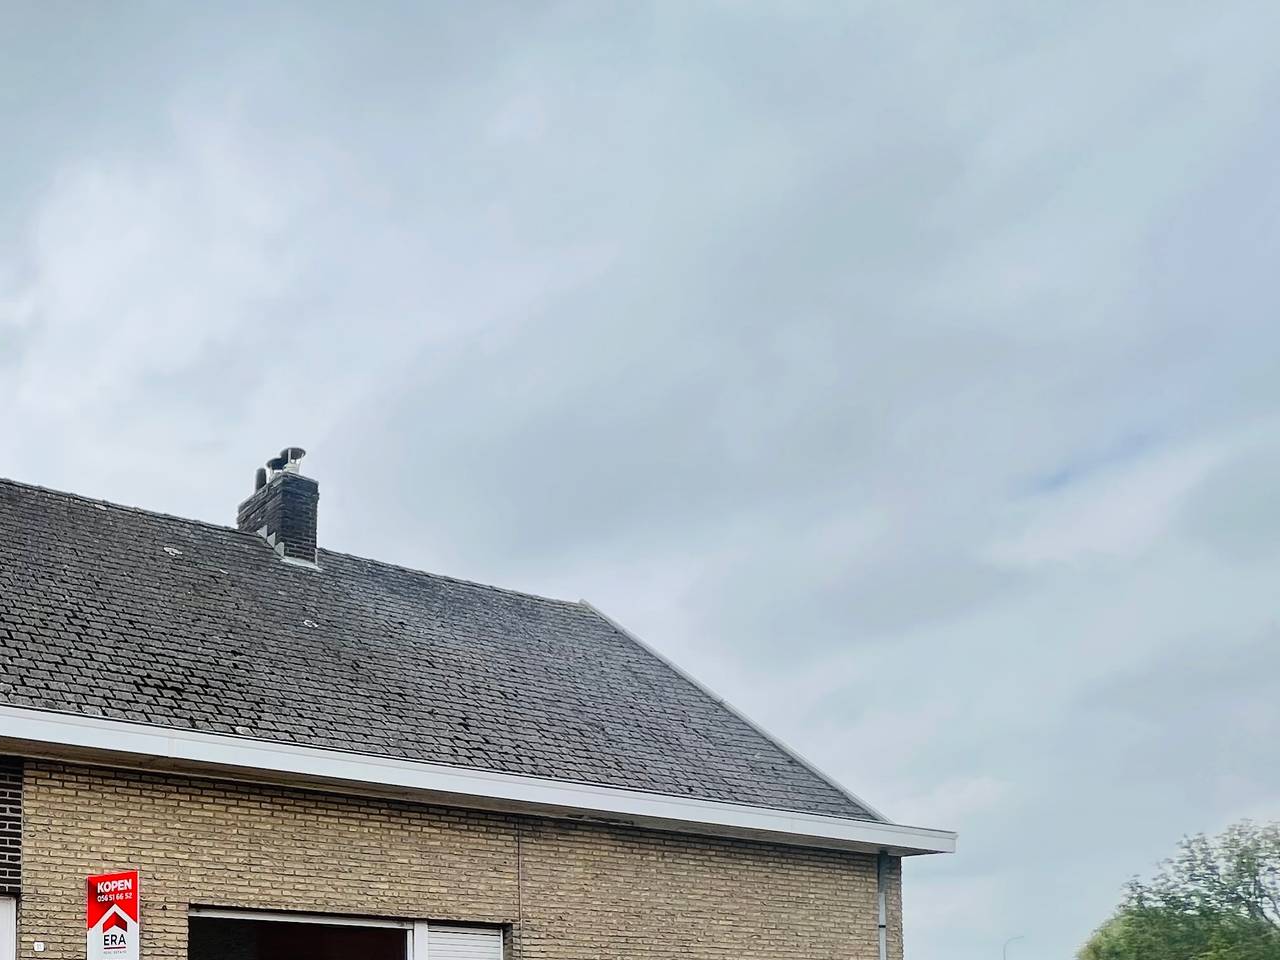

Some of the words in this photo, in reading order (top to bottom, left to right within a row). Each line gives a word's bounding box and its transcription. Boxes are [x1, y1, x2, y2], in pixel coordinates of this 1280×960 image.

[97, 879, 132, 893] KOPEN
[97, 894, 108, 902] 056
[103, 934, 126, 946] ERA
